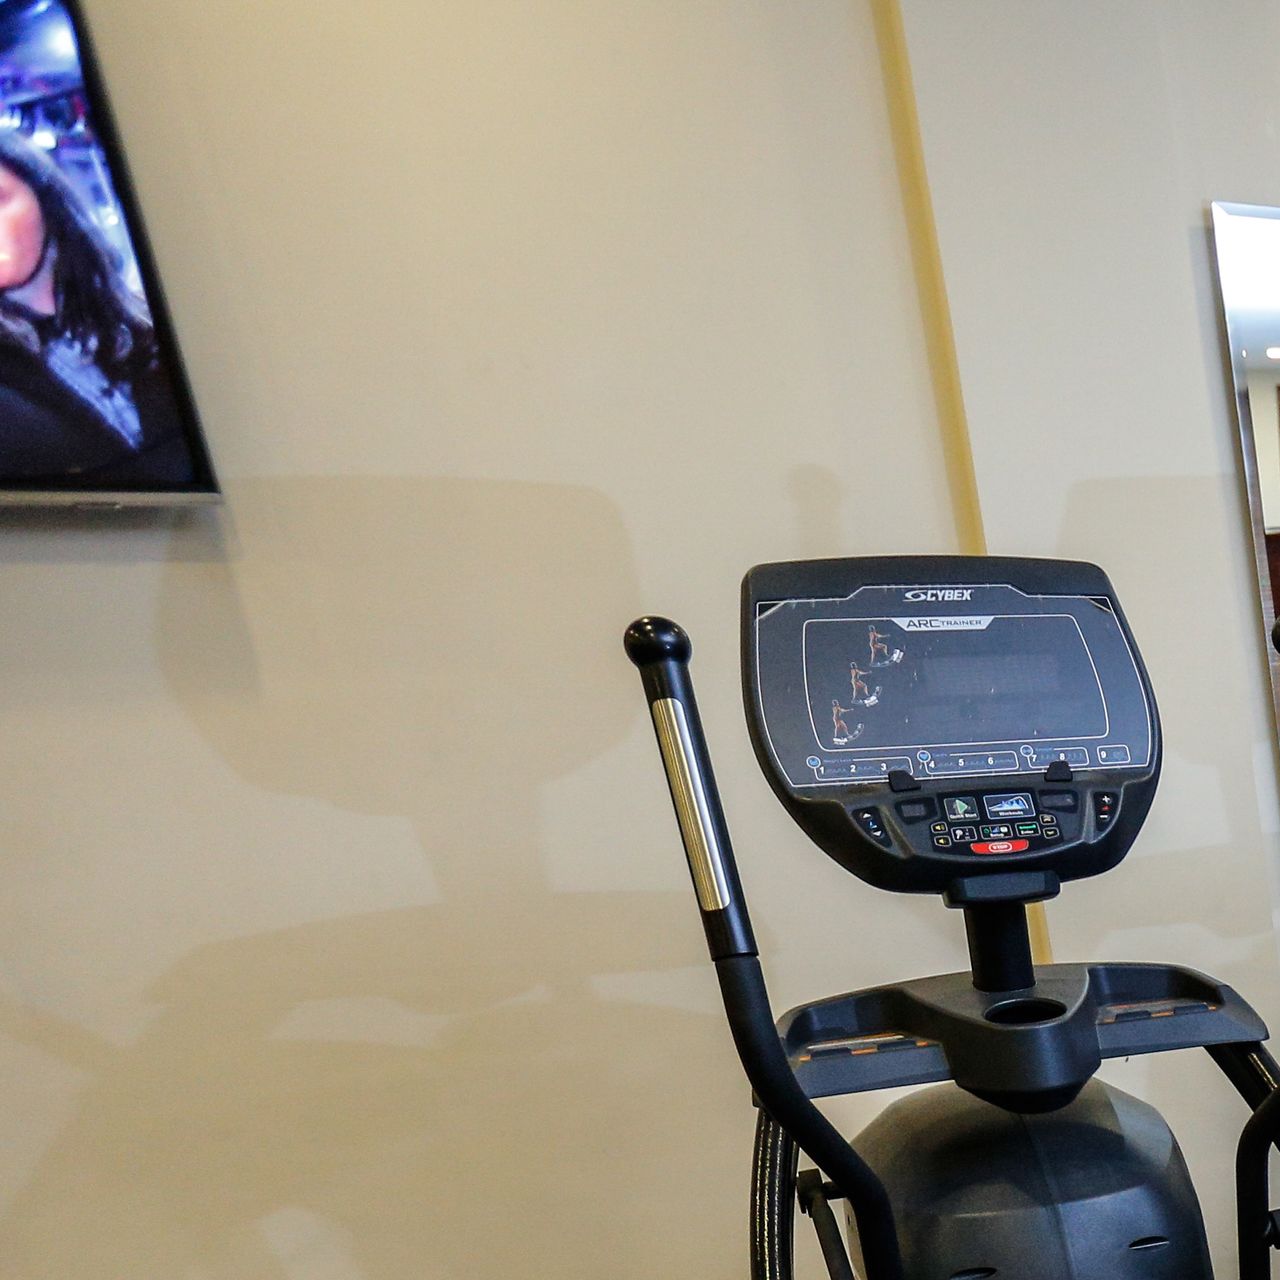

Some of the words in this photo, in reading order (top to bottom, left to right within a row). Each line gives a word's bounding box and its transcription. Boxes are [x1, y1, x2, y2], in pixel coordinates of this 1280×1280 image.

[926, 589, 972, 601] CYBEX
[906, 619, 941, 629] ARC
[941, 619, 982, 627] TRAINER
[1031, 754, 1037, 762] 7
[1059, 752, 1066, 761] 8
[1100, 751, 1107, 759] 9
[928, 760, 935, 769] 4
[958, 759, 965, 767] 5
[987, 757, 994, 765] 6
[820, 766, 825, 775] 1
[850, 765, 856, 773] 2
[880, 763, 887, 771] 3
